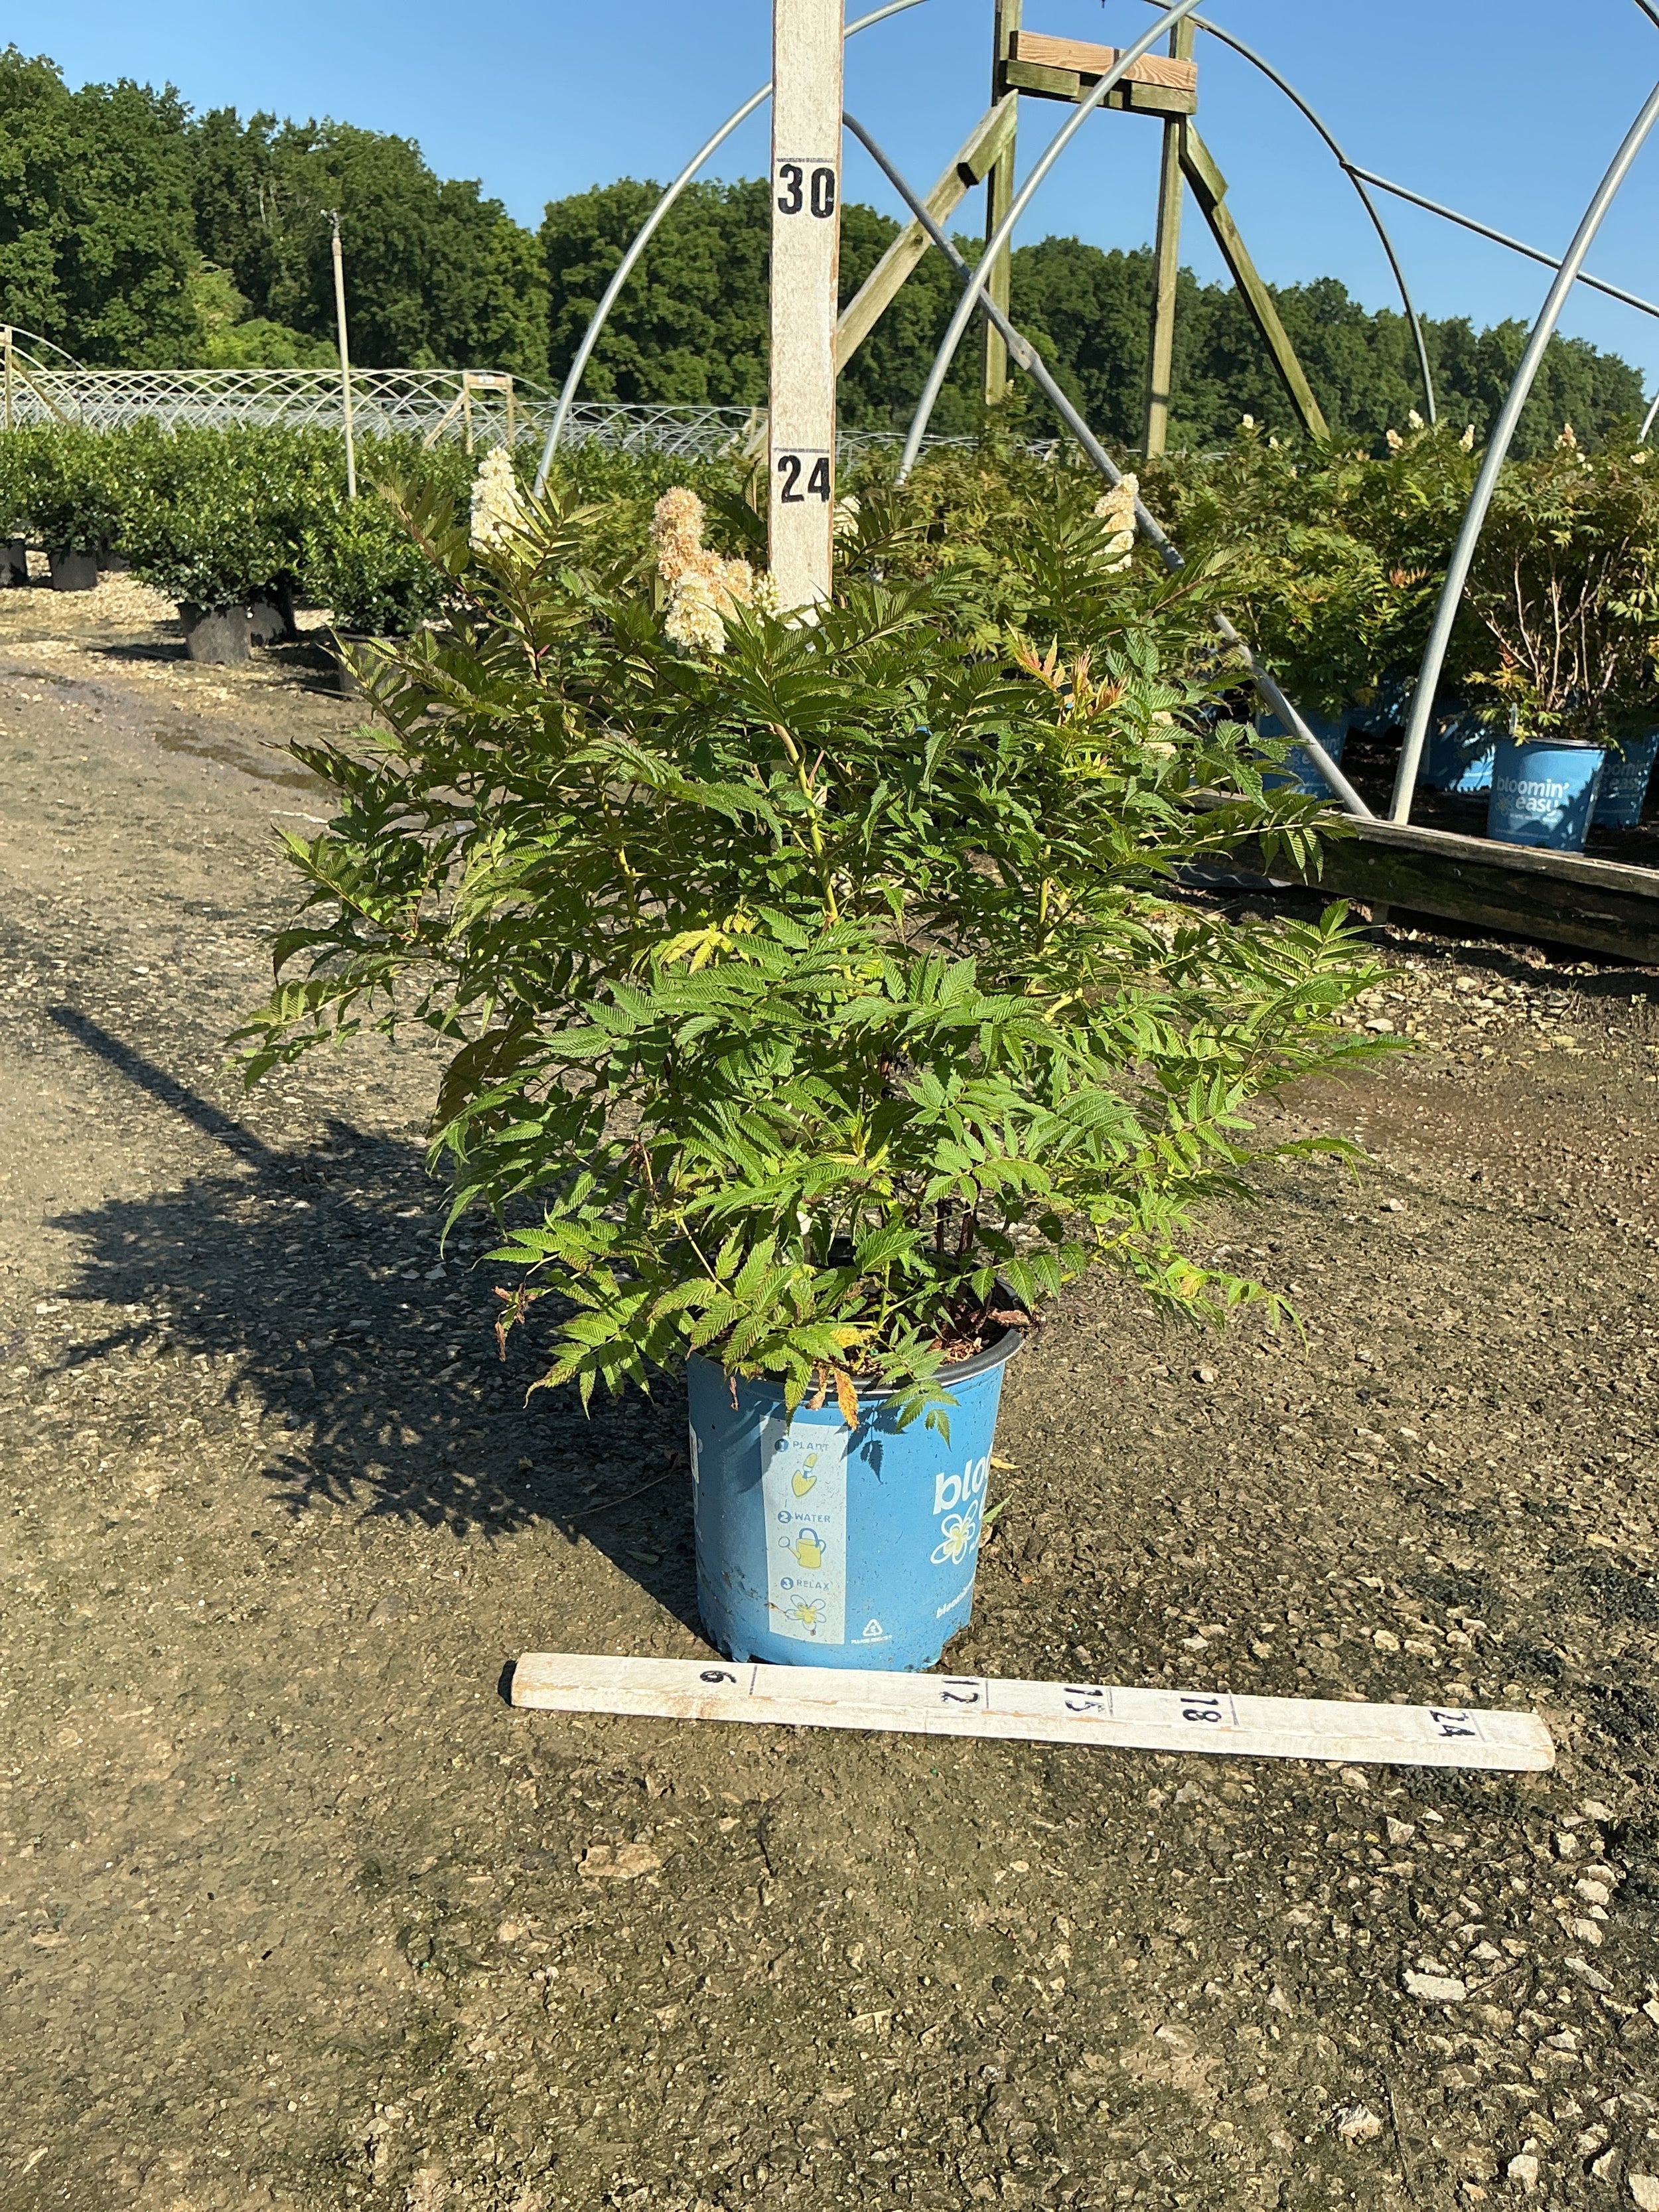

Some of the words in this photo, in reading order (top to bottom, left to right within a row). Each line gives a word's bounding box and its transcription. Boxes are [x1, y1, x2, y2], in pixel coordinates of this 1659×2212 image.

[778, 163, 835, 218] 30
[777, 455, 831, 504] 24
[1496, 775, 1570, 799] bloomin'
[792, 1441, 829, 1451] PLANT
[794, 1512, 831, 1523] WATER
[796, 1579, 830, 1591] RELAX
[699, 1670, 737, 1684] 6
[940, 1677, 979, 1704] 12
[1064, 1687, 1106, 1712] 15
[1180, 1696, 1222, 1723] 18
[1429, 1710, 1476, 1737] 24
